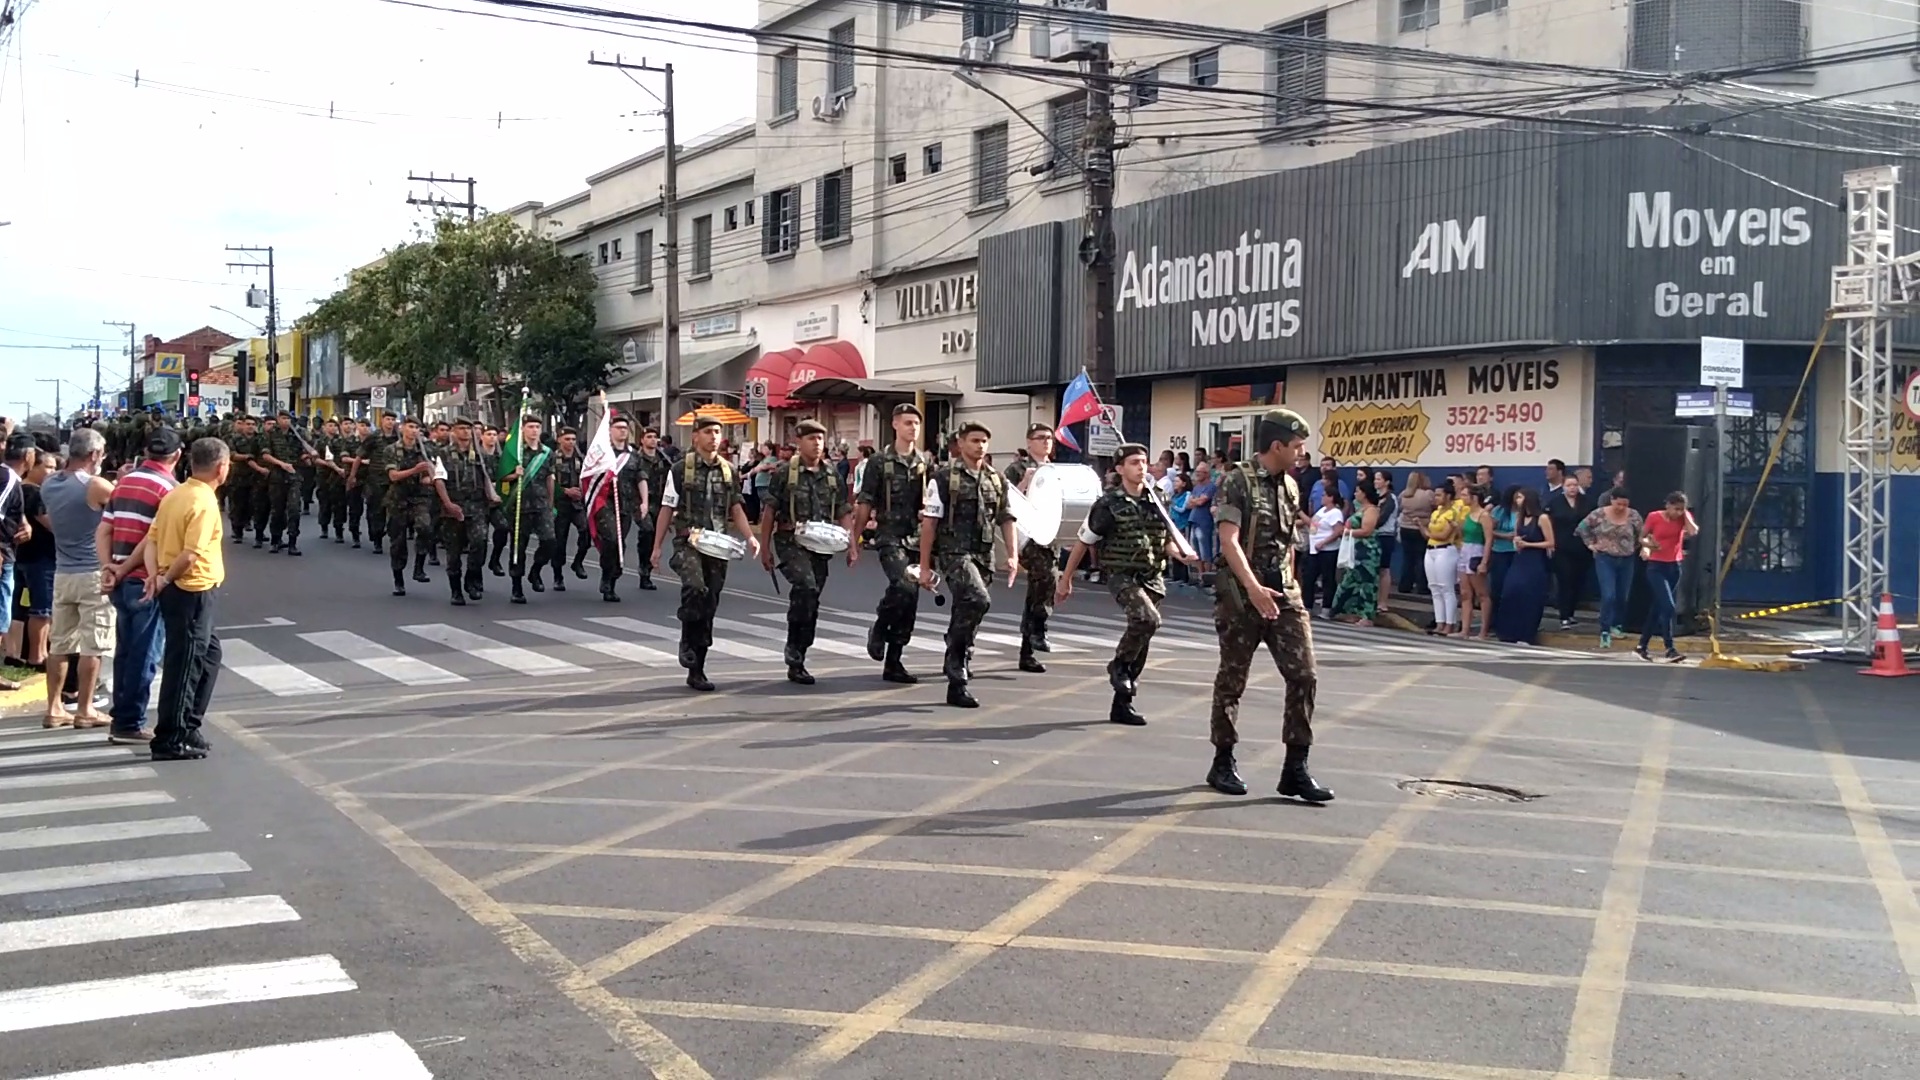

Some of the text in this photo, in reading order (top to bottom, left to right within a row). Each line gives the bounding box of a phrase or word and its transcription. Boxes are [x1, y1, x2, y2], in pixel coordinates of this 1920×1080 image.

[1627, 191, 1811, 248] Moveis
[1402, 215, 1486, 278] AM
[1116, 228, 1302, 312] Adamantina
[1700, 255, 1735, 275] em
[1654, 281, 1768, 318] Geral
[1192, 297, 1300, 347] MÓVEIS
[1322, 358, 1560, 404] ADAMANTINA MÓVEIS
[198, 396, 230, 407] Posto
[1446, 402, 1543, 426] 3522-5490
[1351, 420, 1367, 436] NO
[1169, 436, 1187, 450] 506
[1331, 441, 1347, 457] OU
[1347, 440, 1363, 456] NO
[1445, 431, 1536, 453] 99764-1513
